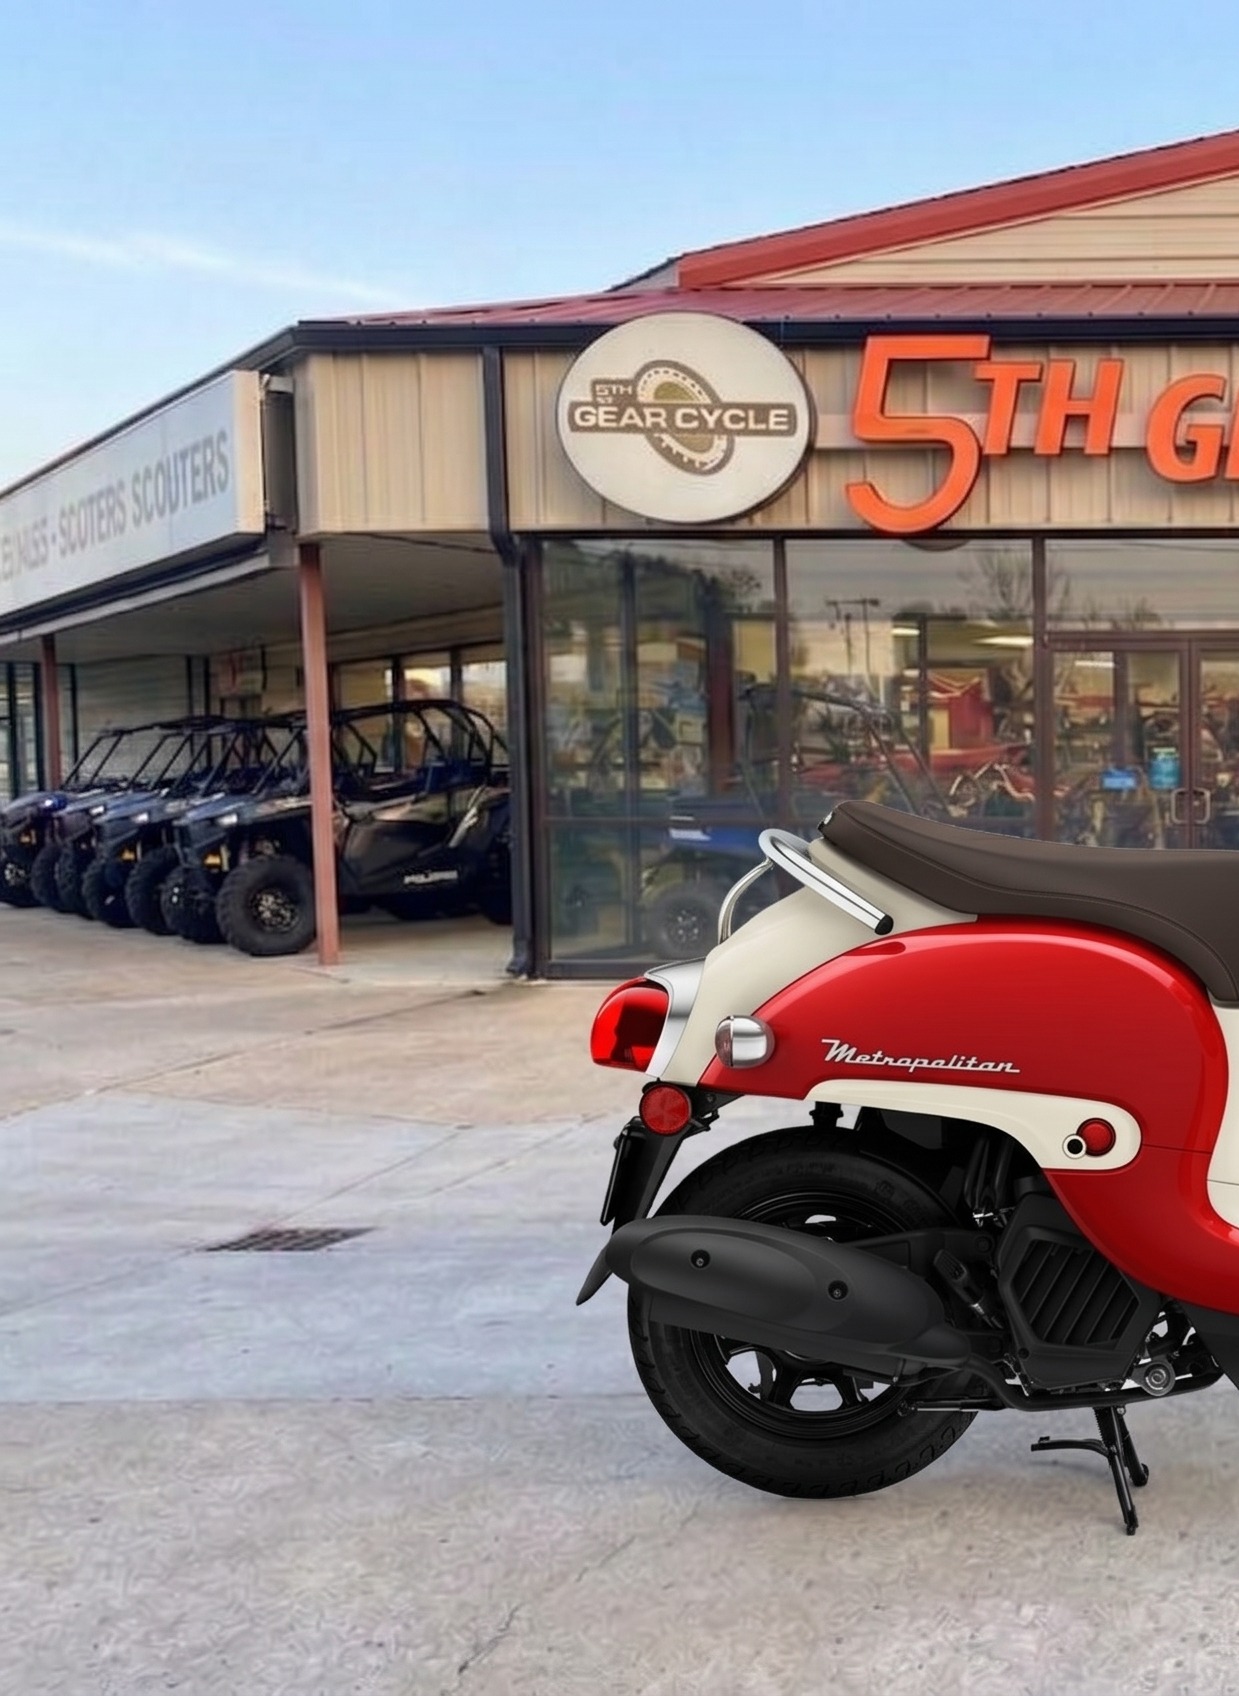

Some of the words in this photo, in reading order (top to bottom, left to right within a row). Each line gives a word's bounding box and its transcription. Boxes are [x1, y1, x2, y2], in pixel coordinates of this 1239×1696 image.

[595, 384, 632, 396] 5TH
[574, 405, 668, 429] GEAR
[674, 408, 790, 431] CYCLE
[842, 335, 1125, 533] 5TH
[131, 430, 228, 527] SCOUTERS
[821, 1038, 1020, 1073] Metropolitan
